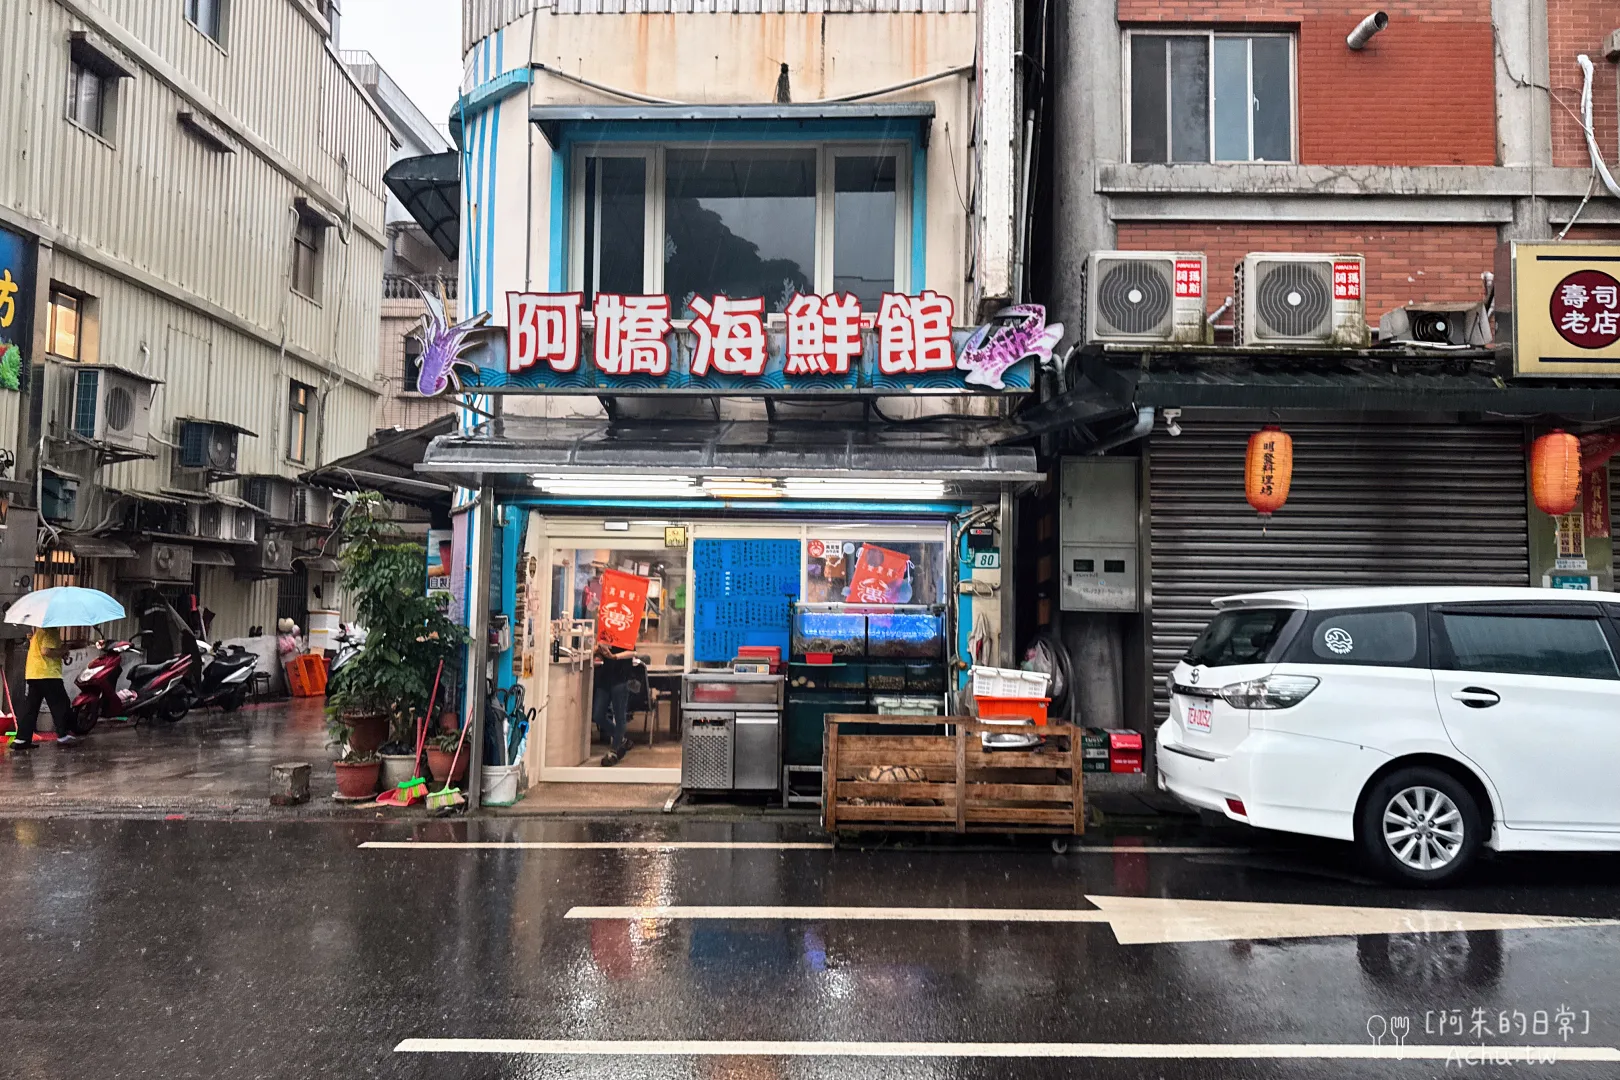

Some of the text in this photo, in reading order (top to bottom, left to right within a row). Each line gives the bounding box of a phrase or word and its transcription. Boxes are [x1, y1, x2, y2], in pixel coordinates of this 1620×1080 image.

[1561, 284, 1618, 309] 壽司
[506, 291, 955, 376] 阿嬌海鮮館
[1561, 310, 1620, 335] 老店
[980, 554, 995, 566] 80
